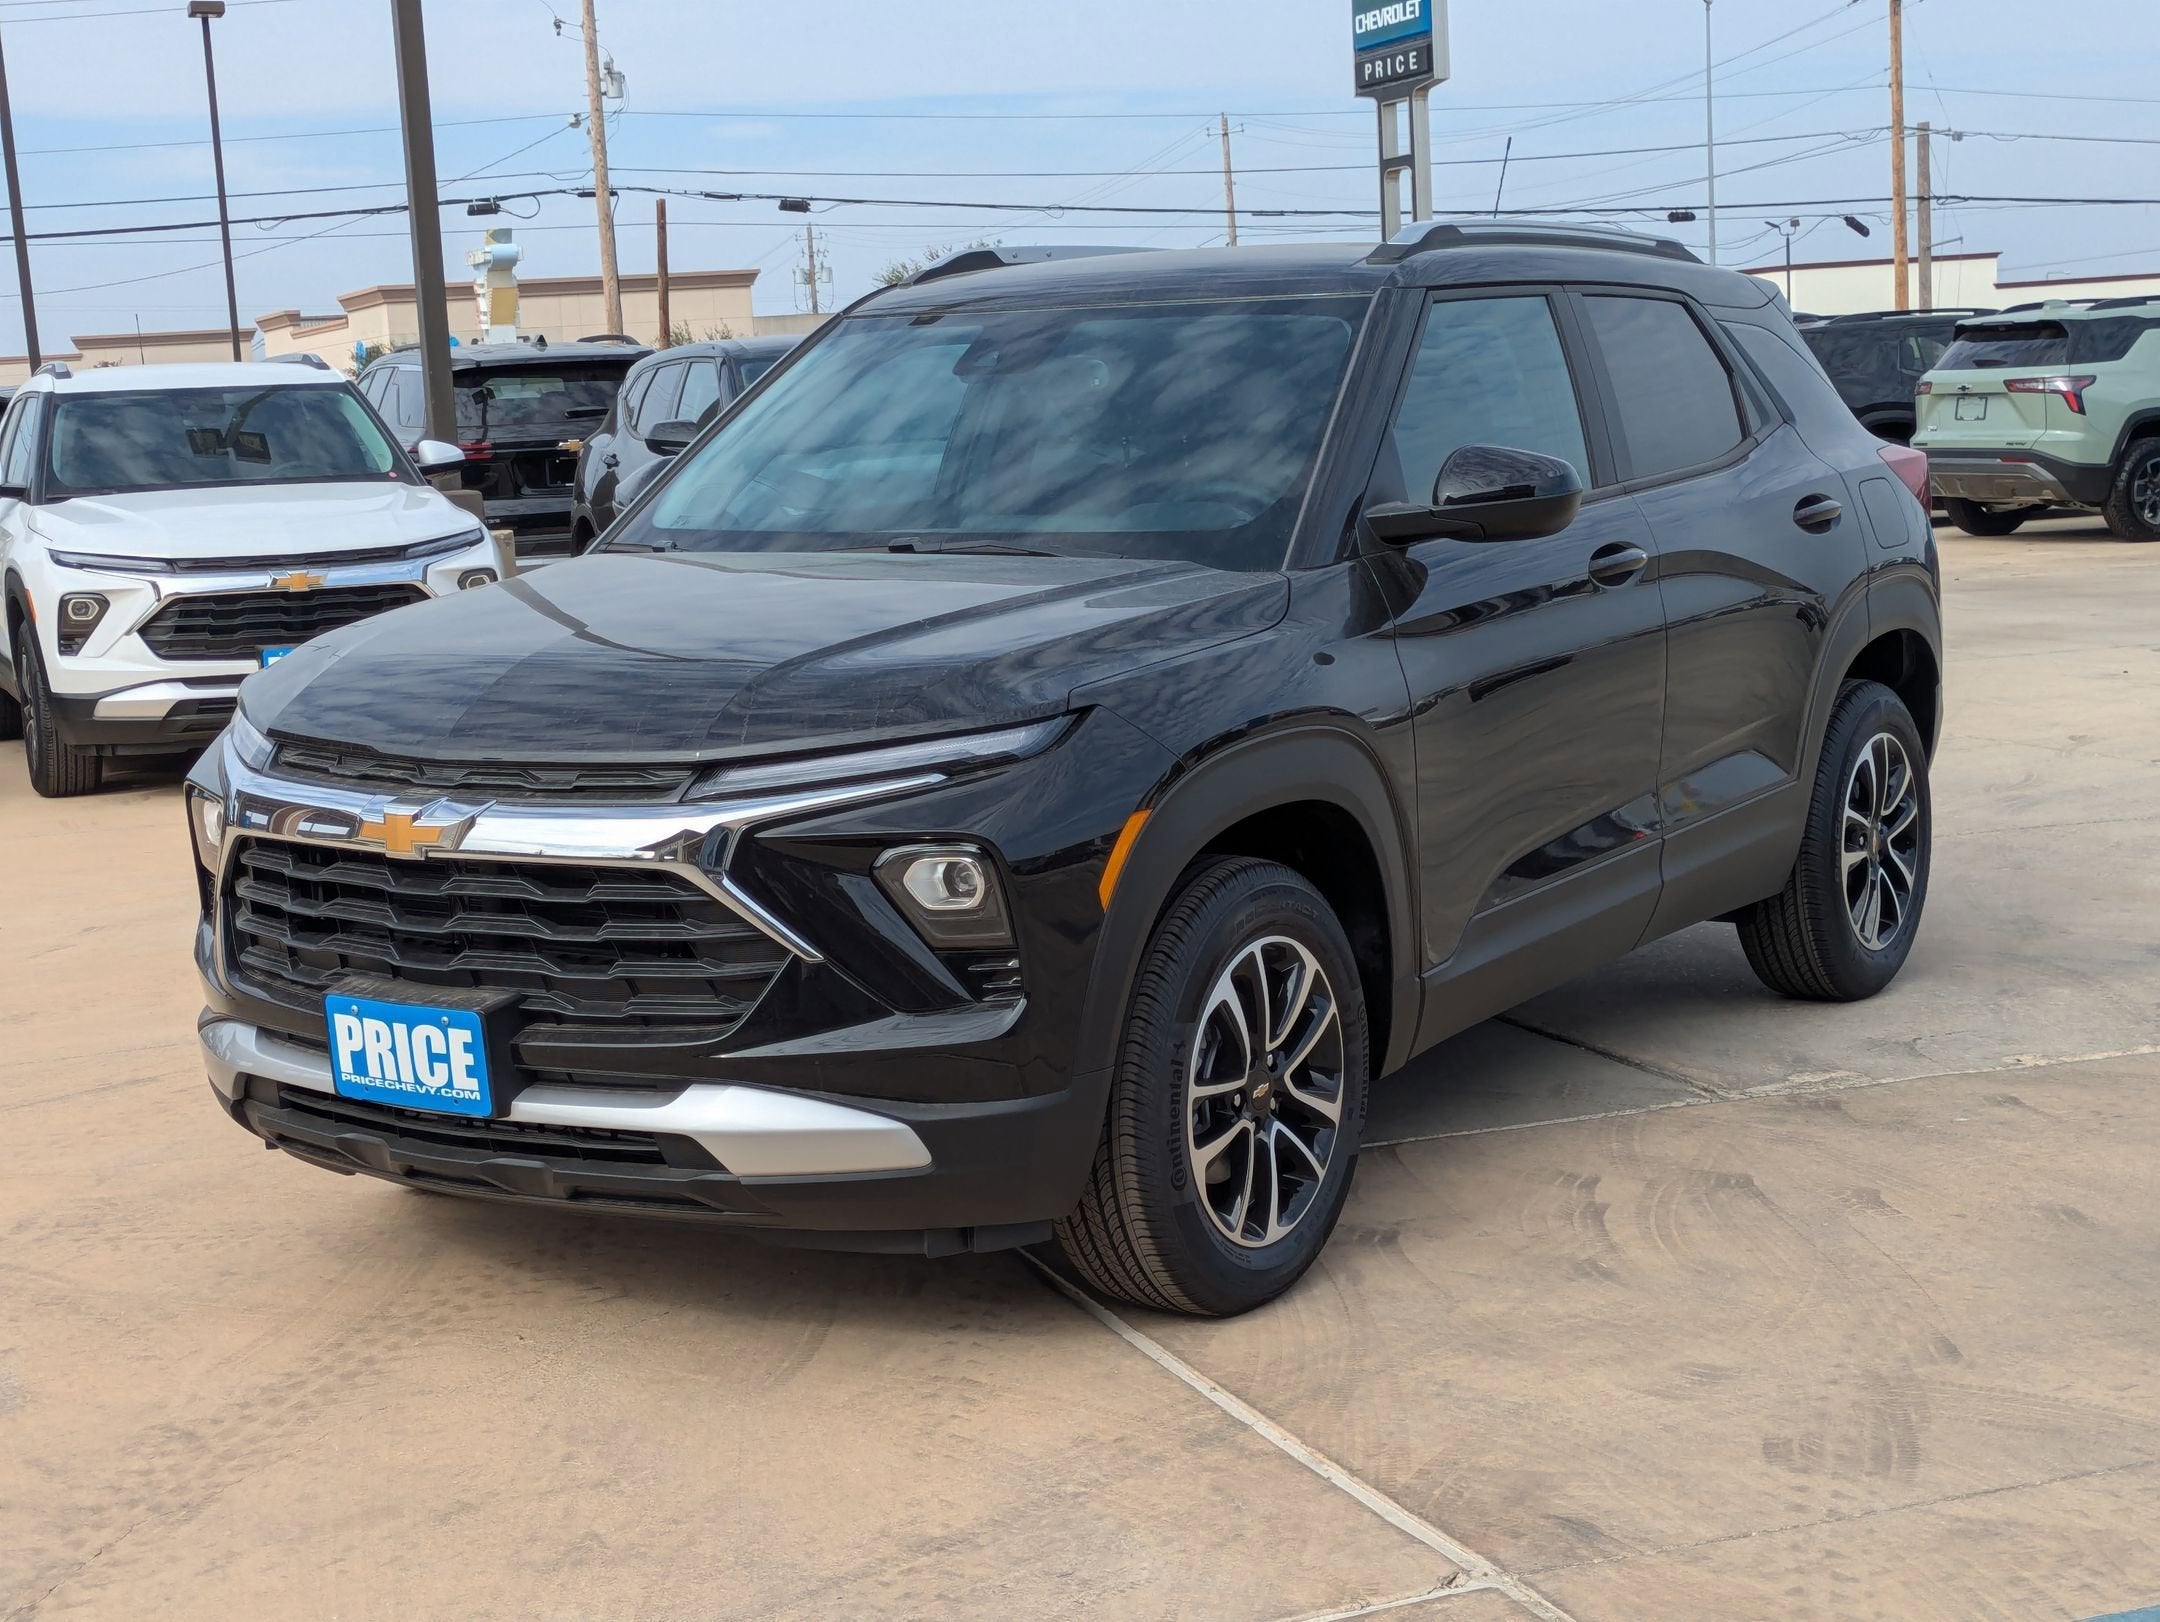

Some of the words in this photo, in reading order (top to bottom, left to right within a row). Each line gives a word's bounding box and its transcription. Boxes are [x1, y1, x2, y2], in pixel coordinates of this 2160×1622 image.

[1355, 0, 1420, 34] CHEVROLET
[1364, 51, 1418, 81] PRICE
[334, 1013, 479, 1091] PRICE
[341, 1072, 480, 1100] PRICECHEVY.COM
